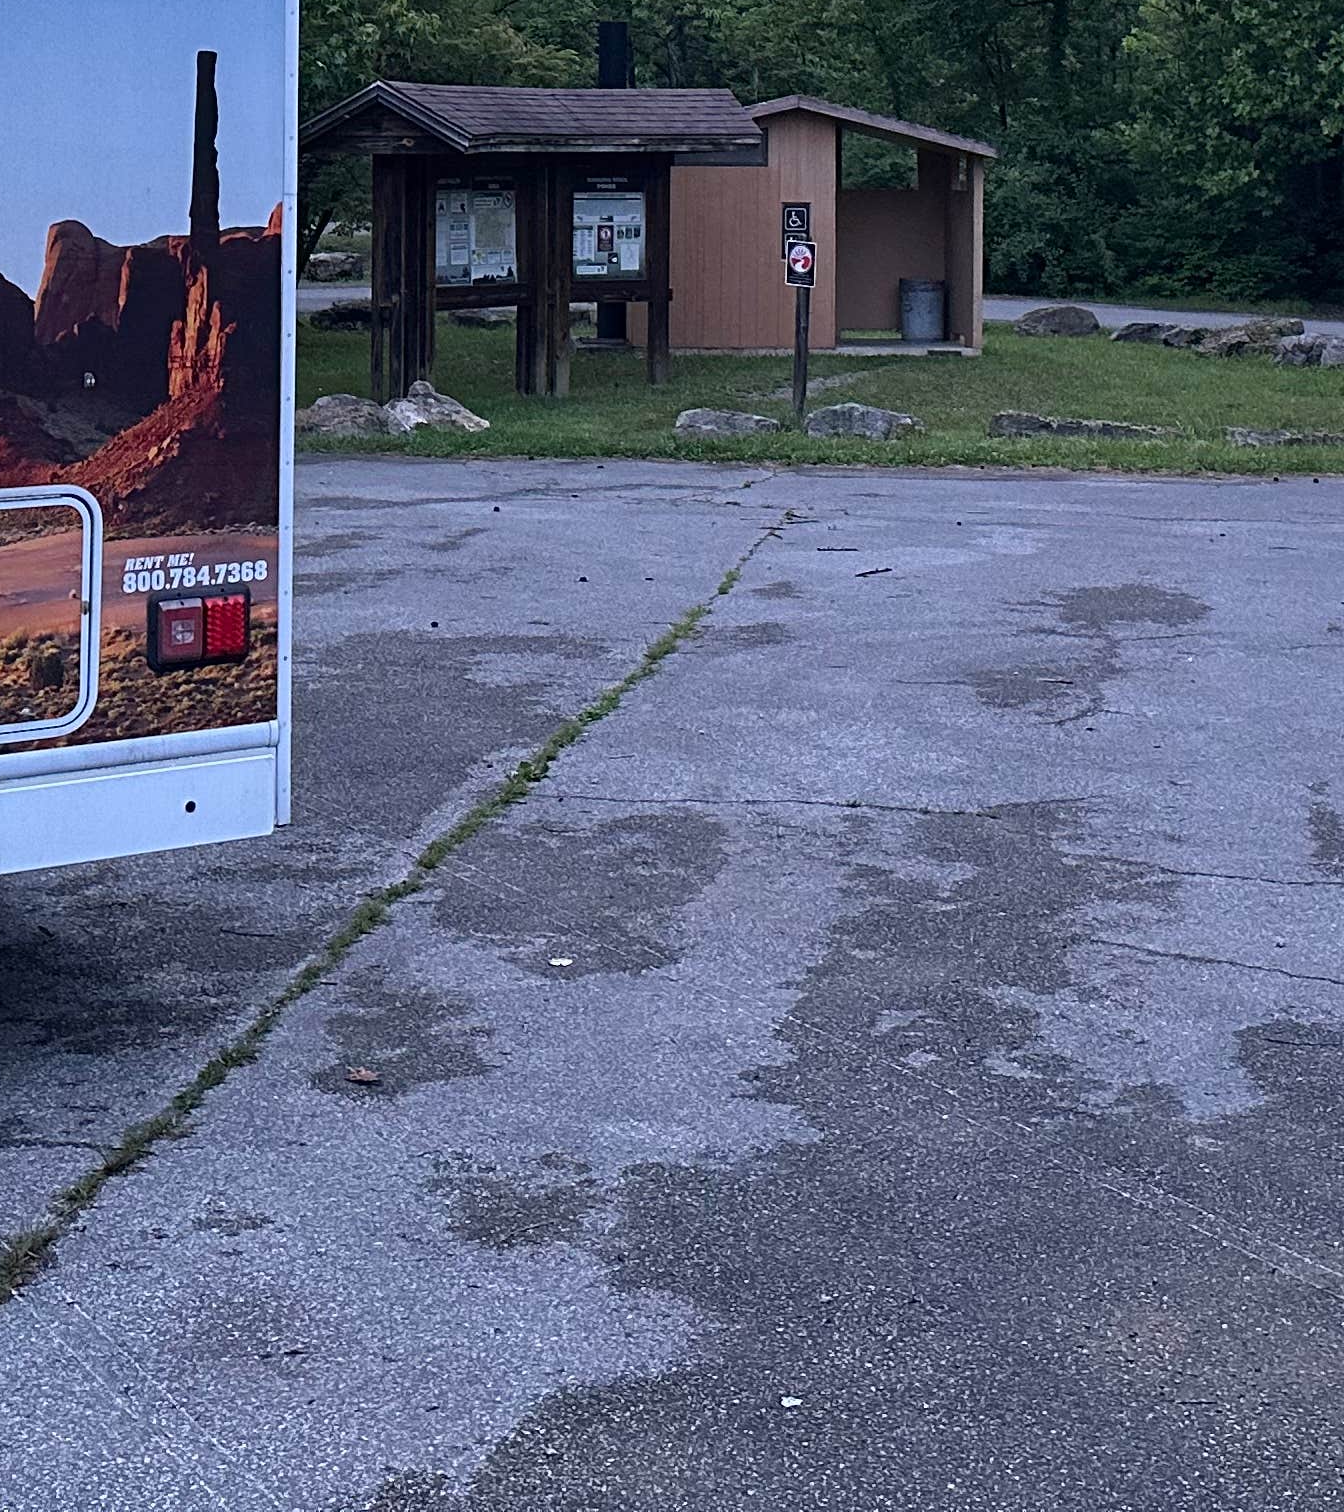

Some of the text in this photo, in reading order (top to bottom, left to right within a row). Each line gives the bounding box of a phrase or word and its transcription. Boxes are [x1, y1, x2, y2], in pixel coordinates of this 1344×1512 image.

[124, 553, 195, 572] RENT ME!
[122, 559, 268, 594] 800.784.7368
